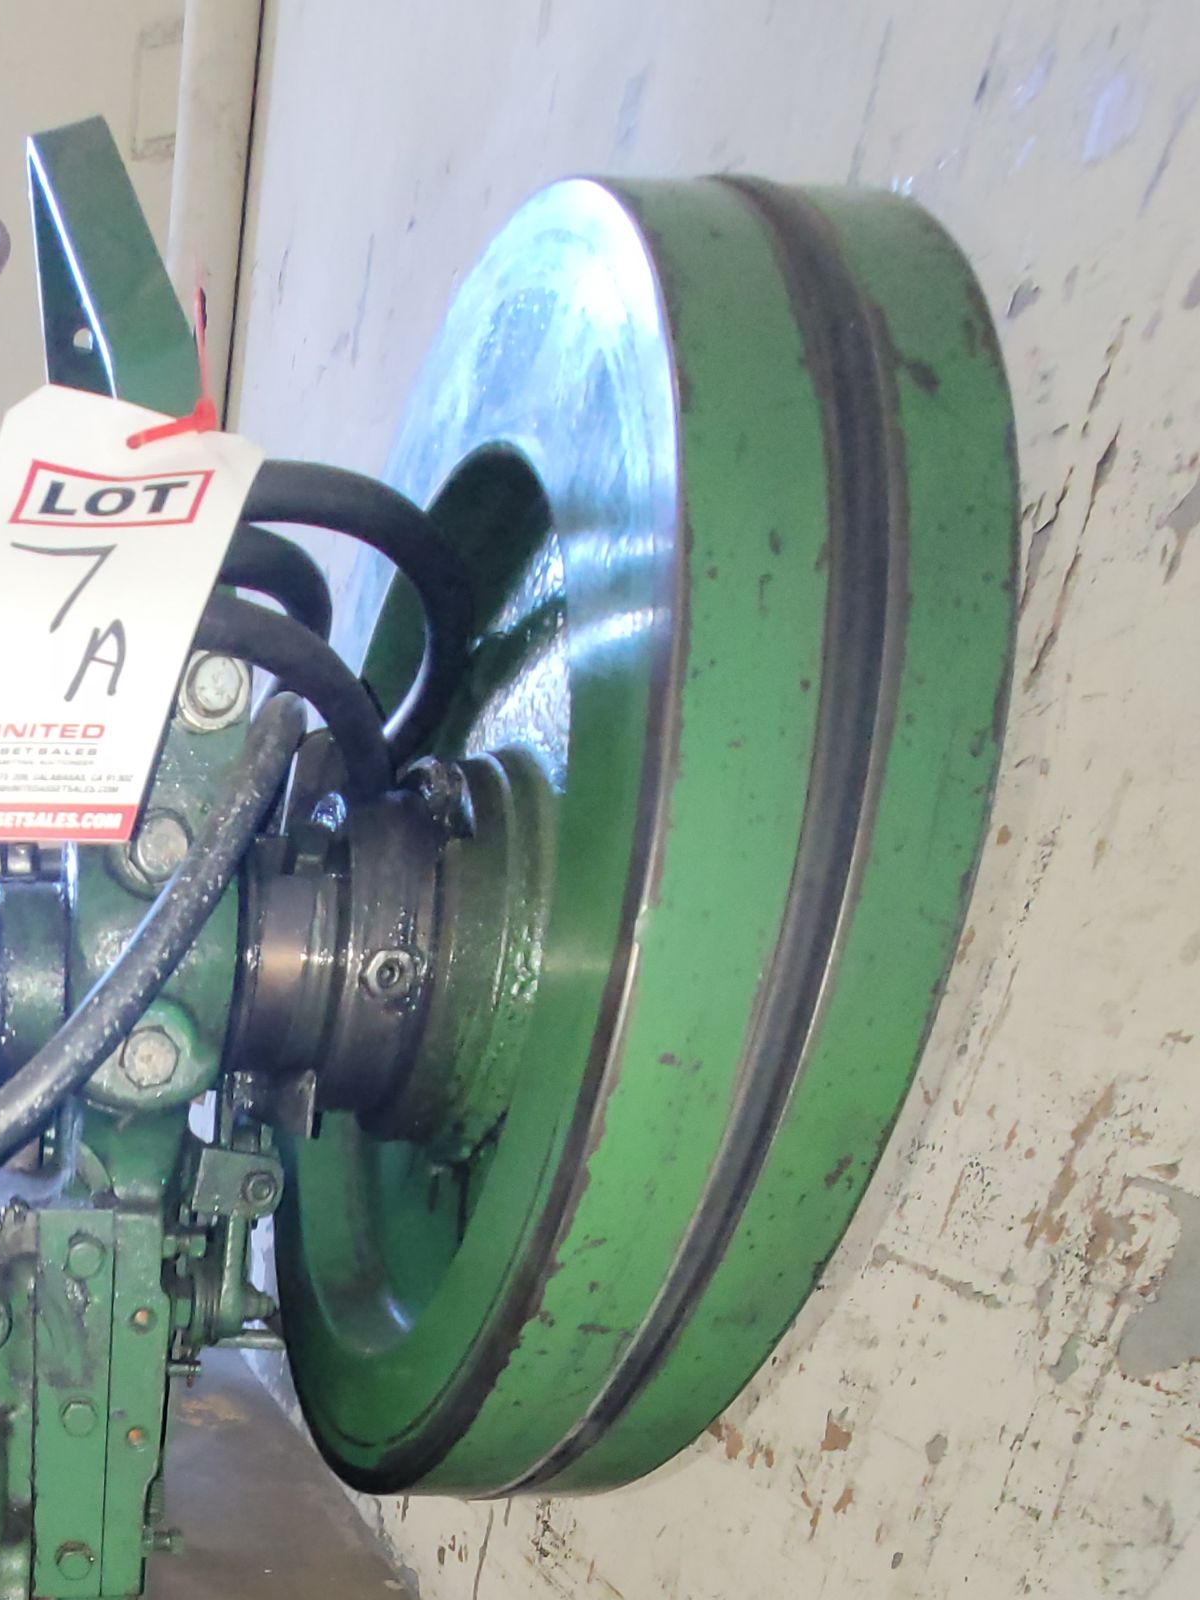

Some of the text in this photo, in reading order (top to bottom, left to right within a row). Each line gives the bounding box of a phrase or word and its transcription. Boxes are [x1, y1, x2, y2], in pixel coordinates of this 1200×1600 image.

[38, 480, 189, 516] LOT
[10, 541, 117, 633] 7
[64, 619, 126, 702] A
[38, 747, 98, 756] SALES
